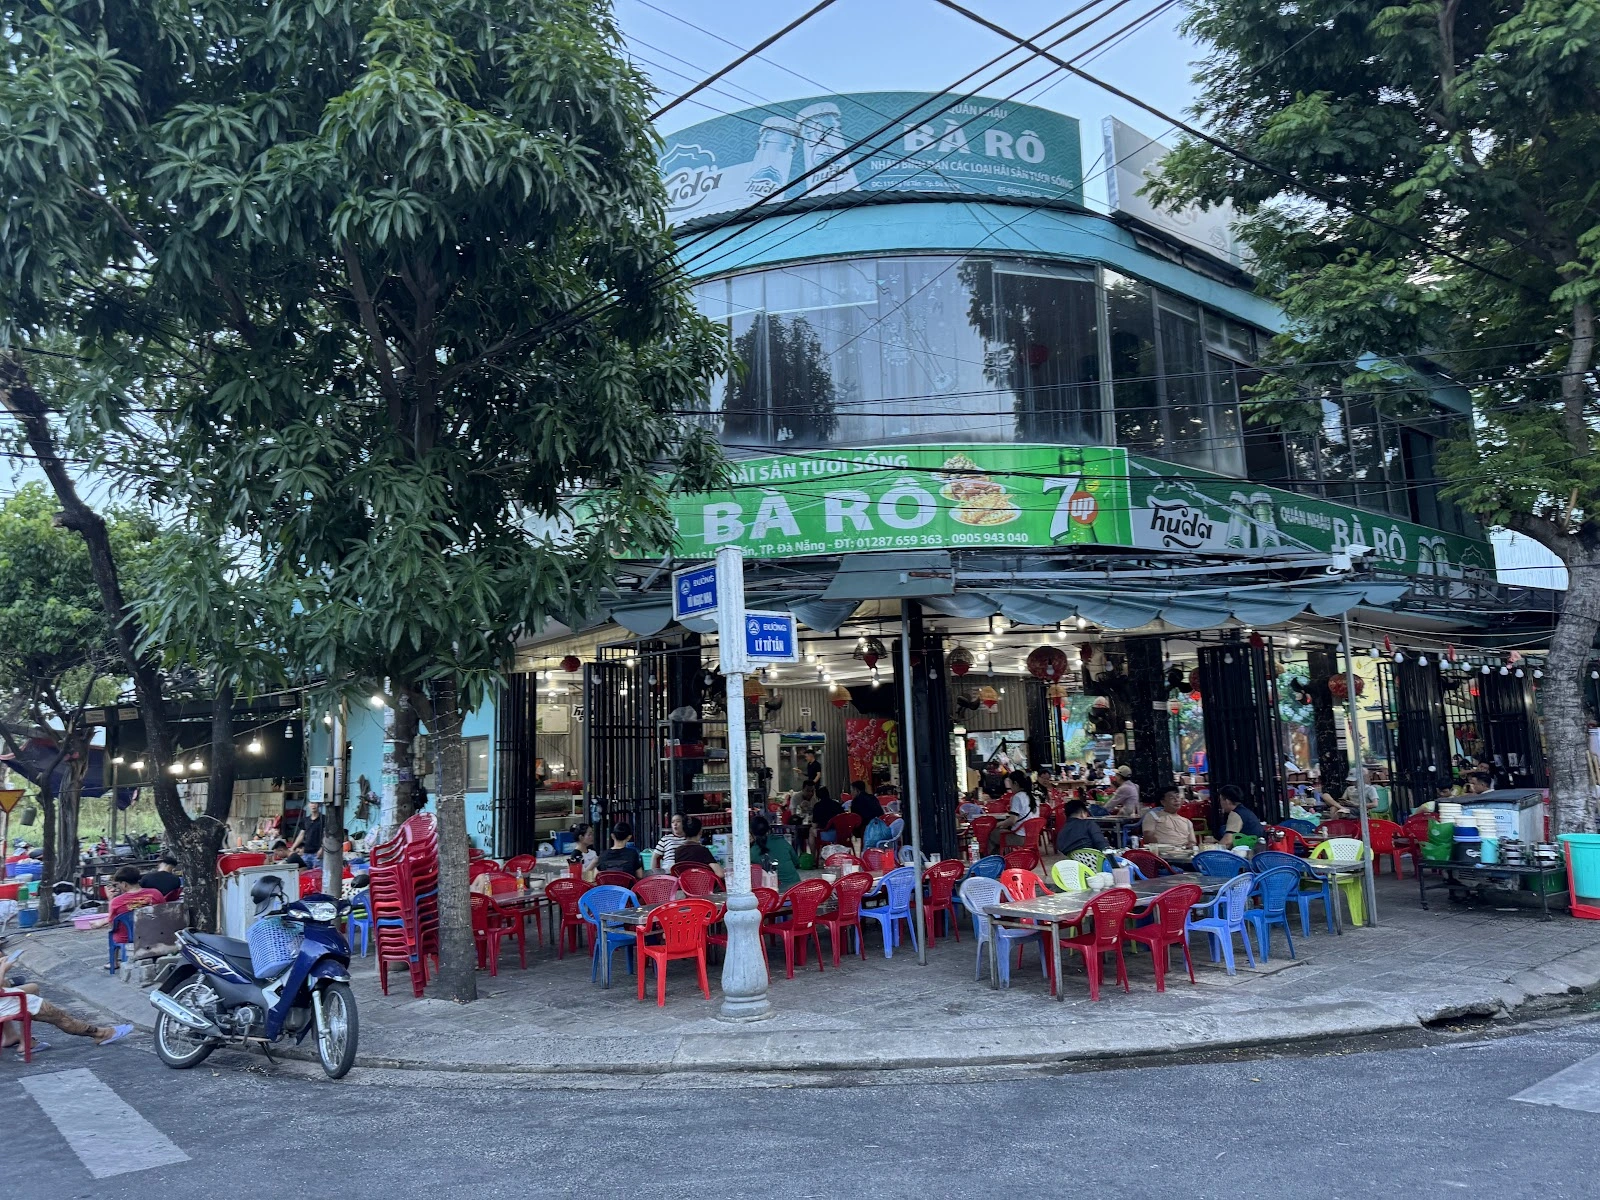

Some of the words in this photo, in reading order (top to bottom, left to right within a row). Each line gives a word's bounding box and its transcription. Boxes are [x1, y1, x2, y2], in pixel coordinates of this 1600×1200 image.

[903, 118, 971, 154] BÀ
[984, 130, 1046, 164] RÔ
[950, 159, 970, 172] CÁC
[971, 162, 993, 175] LOẠI
[759, 460, 797, 480] SẢN
[799, 457, 849, 476] TƯƠI
[852, 451, 909, 471] SỐNG
[703, 487, 802, 545] BÀ
[824, 476, 937, 533] RÔ
[1279, 506, 1306, 526] QUÁN
[1306, 513, 1331, 534] NHẬU
[741, 544, 758, 557] ấn,
[760, 545, 775, 555] TP.
[777, 541, 793, 553] Đà
[795, 538, 826, 554] Nẵng
[834, 538, 855, 549] ĐT:
[856, 536, 895, 548] 01287
[895, 535, 918, 547] 659
[920, 534, 943, 545] 363
[951, 533, 981, 544] 0905
[983, 532, 1005, 543] 943
[1006, 532, 1029, 543] 040
[1333, 514, 1367, 553] BÀ
[1372, 525, 1407, 565] RÔ
[763, 621, 787, 632] ĐƯỜNG
